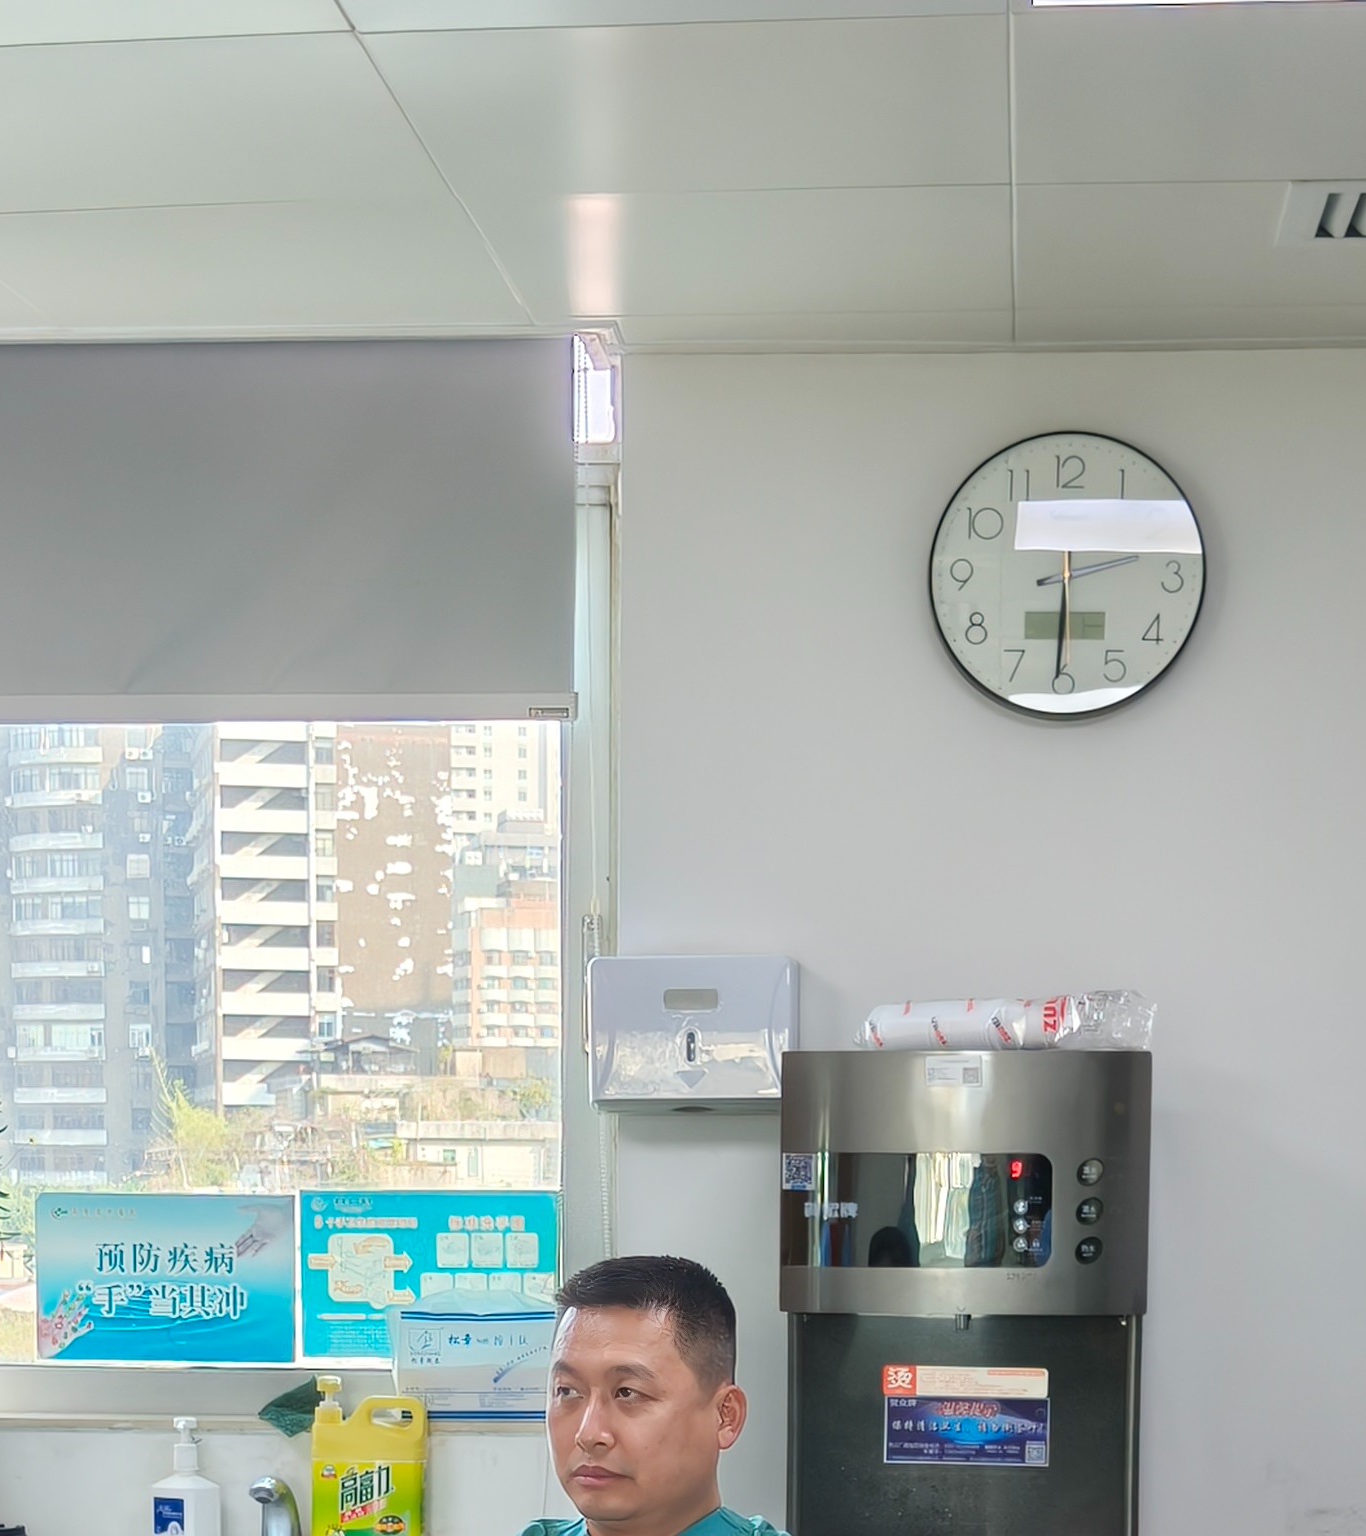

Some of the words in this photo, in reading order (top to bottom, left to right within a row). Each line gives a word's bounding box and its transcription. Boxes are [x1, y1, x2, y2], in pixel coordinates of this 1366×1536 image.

[1007, 469, 1030, 501] 11
[1055, 455, 1085, 489] 12
[1118, 469, 1125, 499] 1
[966, 506, 1004, 540] 10
[950, 558, 974, 591] 9
[1160, 560, 1184, 593] 3
[965, 611, 988, 645] 8
[1141, 613, 1164, 645] 4
[1003, 649, 1026, 682] 7
[1051, 662, 1075, 695] 6
[1103, 650, 1127, 683] 5
[95, 1242, 235, 1275] 预防疾病
[887, 1366, 913, 1390] 烫
